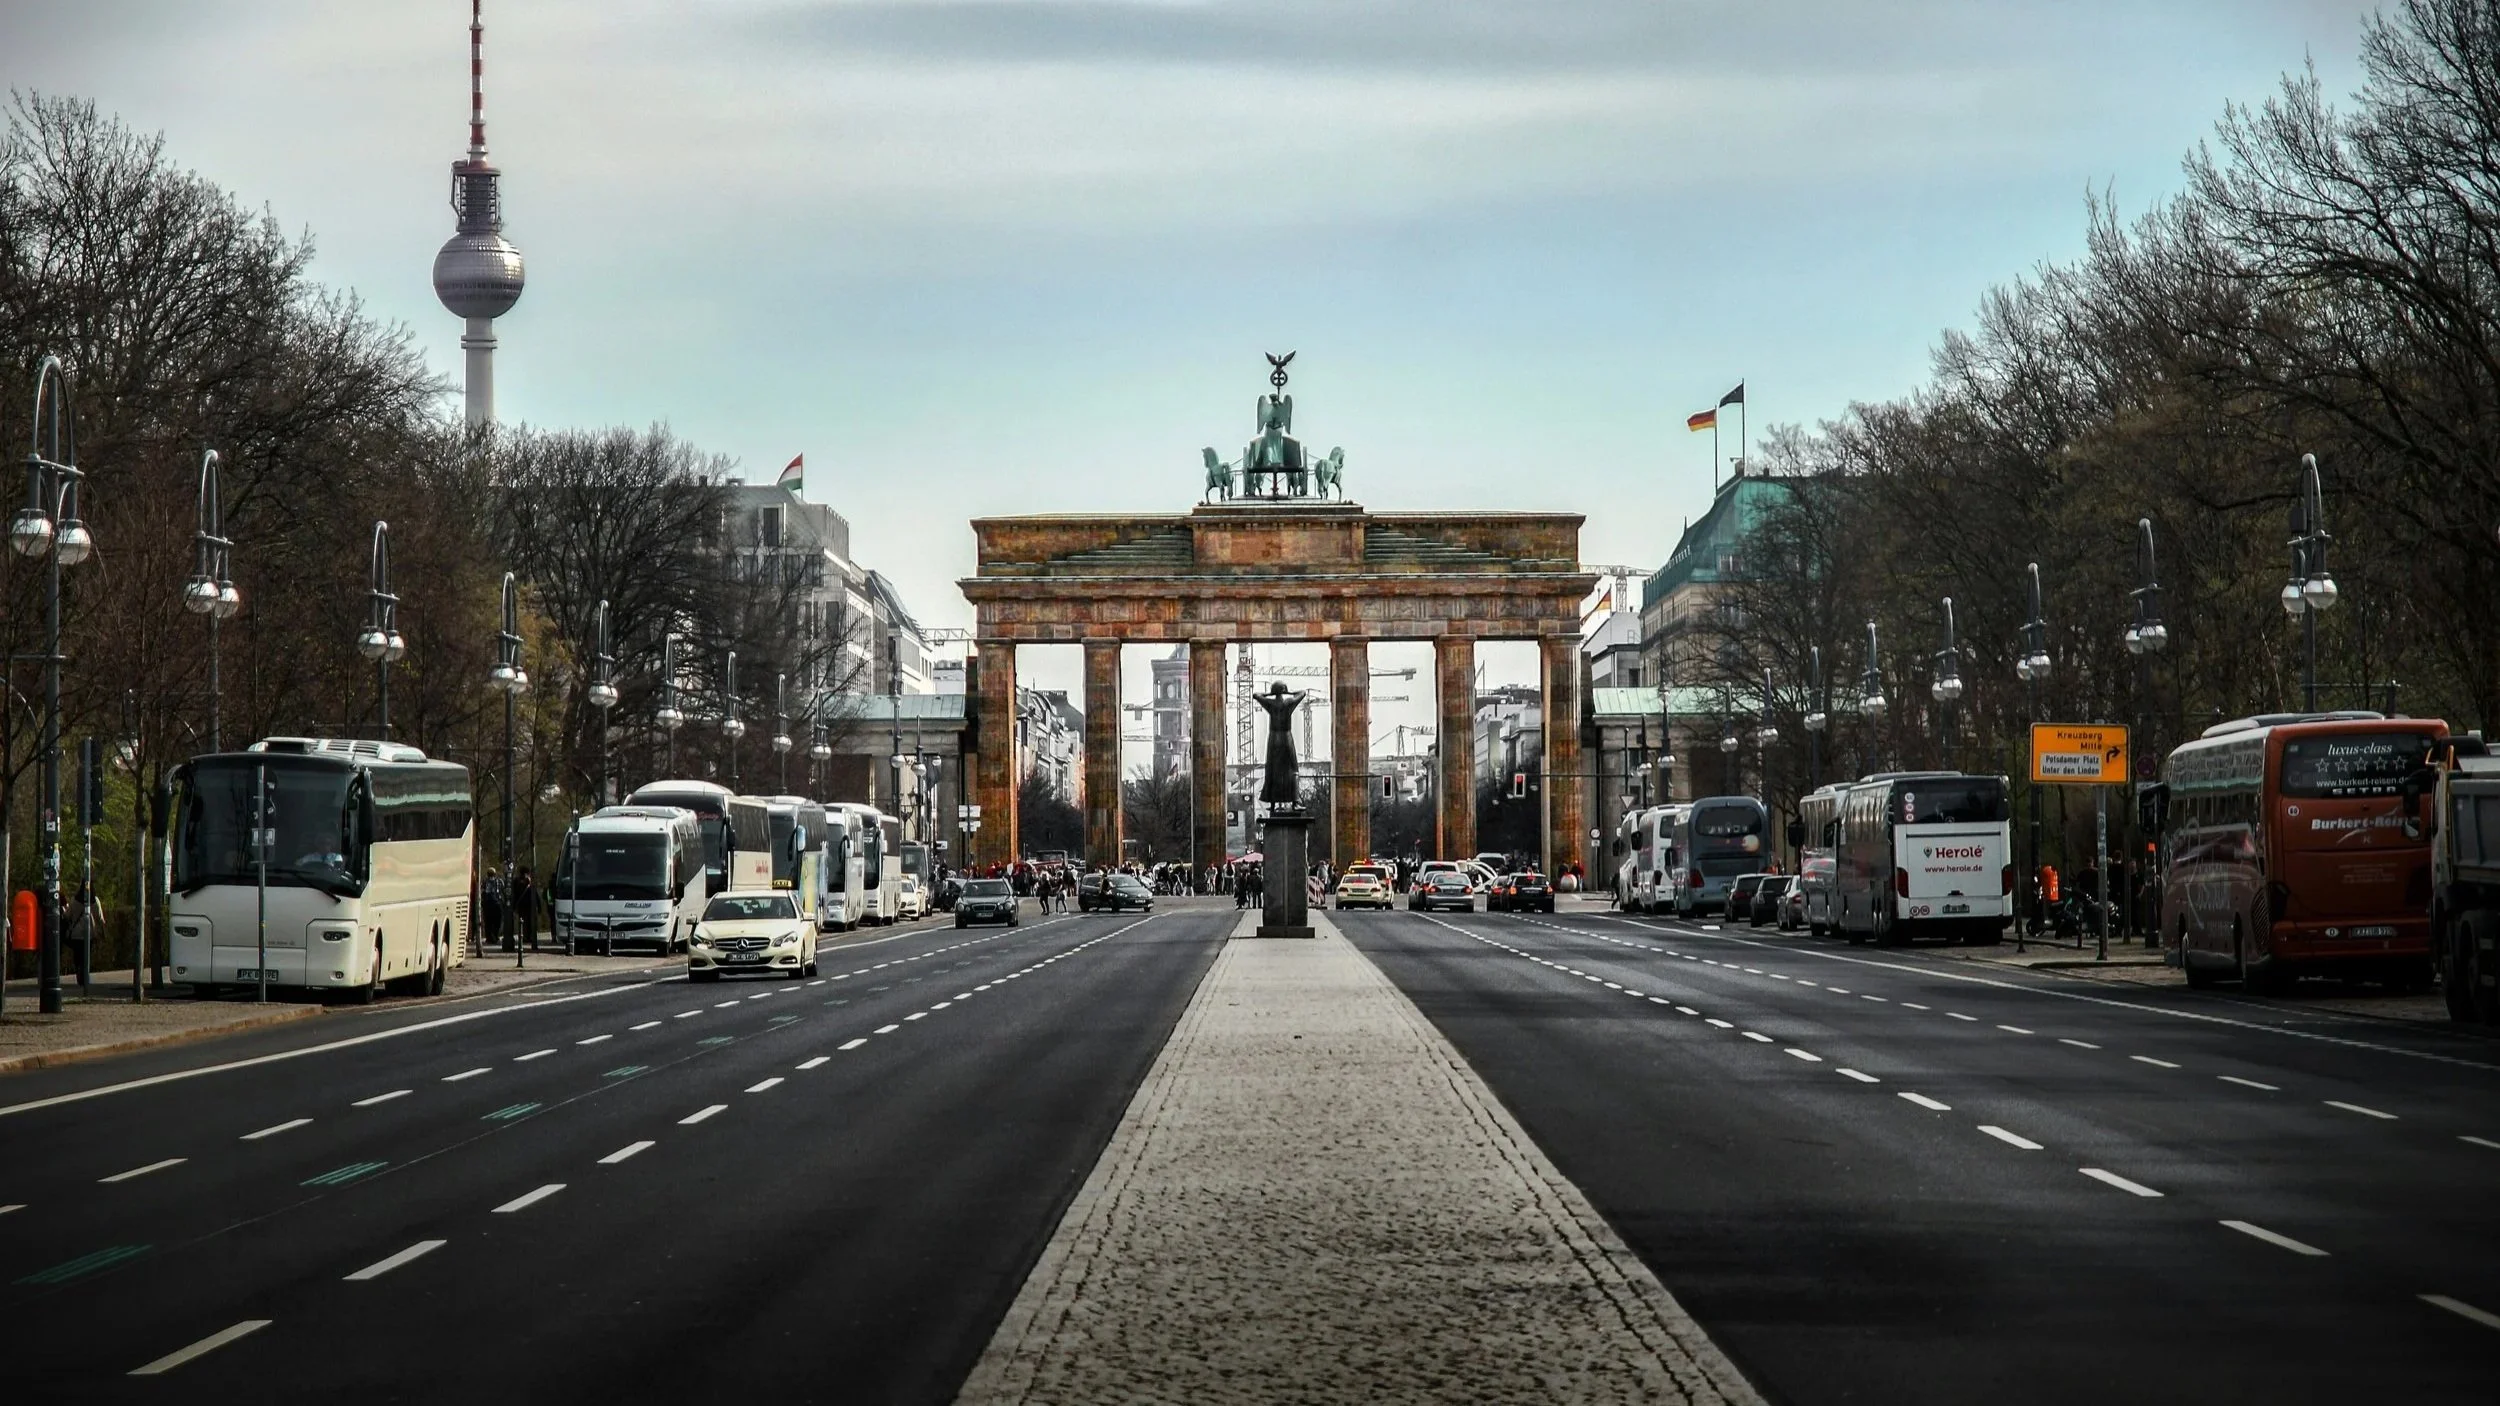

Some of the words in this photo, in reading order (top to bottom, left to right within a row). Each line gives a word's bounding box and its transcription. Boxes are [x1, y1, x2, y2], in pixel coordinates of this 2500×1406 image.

[2057, 731, 2102, 740] Kreuzberg
[2080, 743, 2103, 751] Mitte
[2327, 742, 2393, 756] luxus-class
[2045, 755, 2080, 764] Potsdamer
[2083, 755, 2099, 764] Platz
[2042, 766, 2060, 774] Unter
[2063, 766, 2076, 775] den
[2078, 766, 2100, 775] Linden
[2311, 816, 2404, 830] Burkert-Reis
[1935, 845, 1983, 859] Herolé
[1924, 864, 1983, 873] www.herole.de
